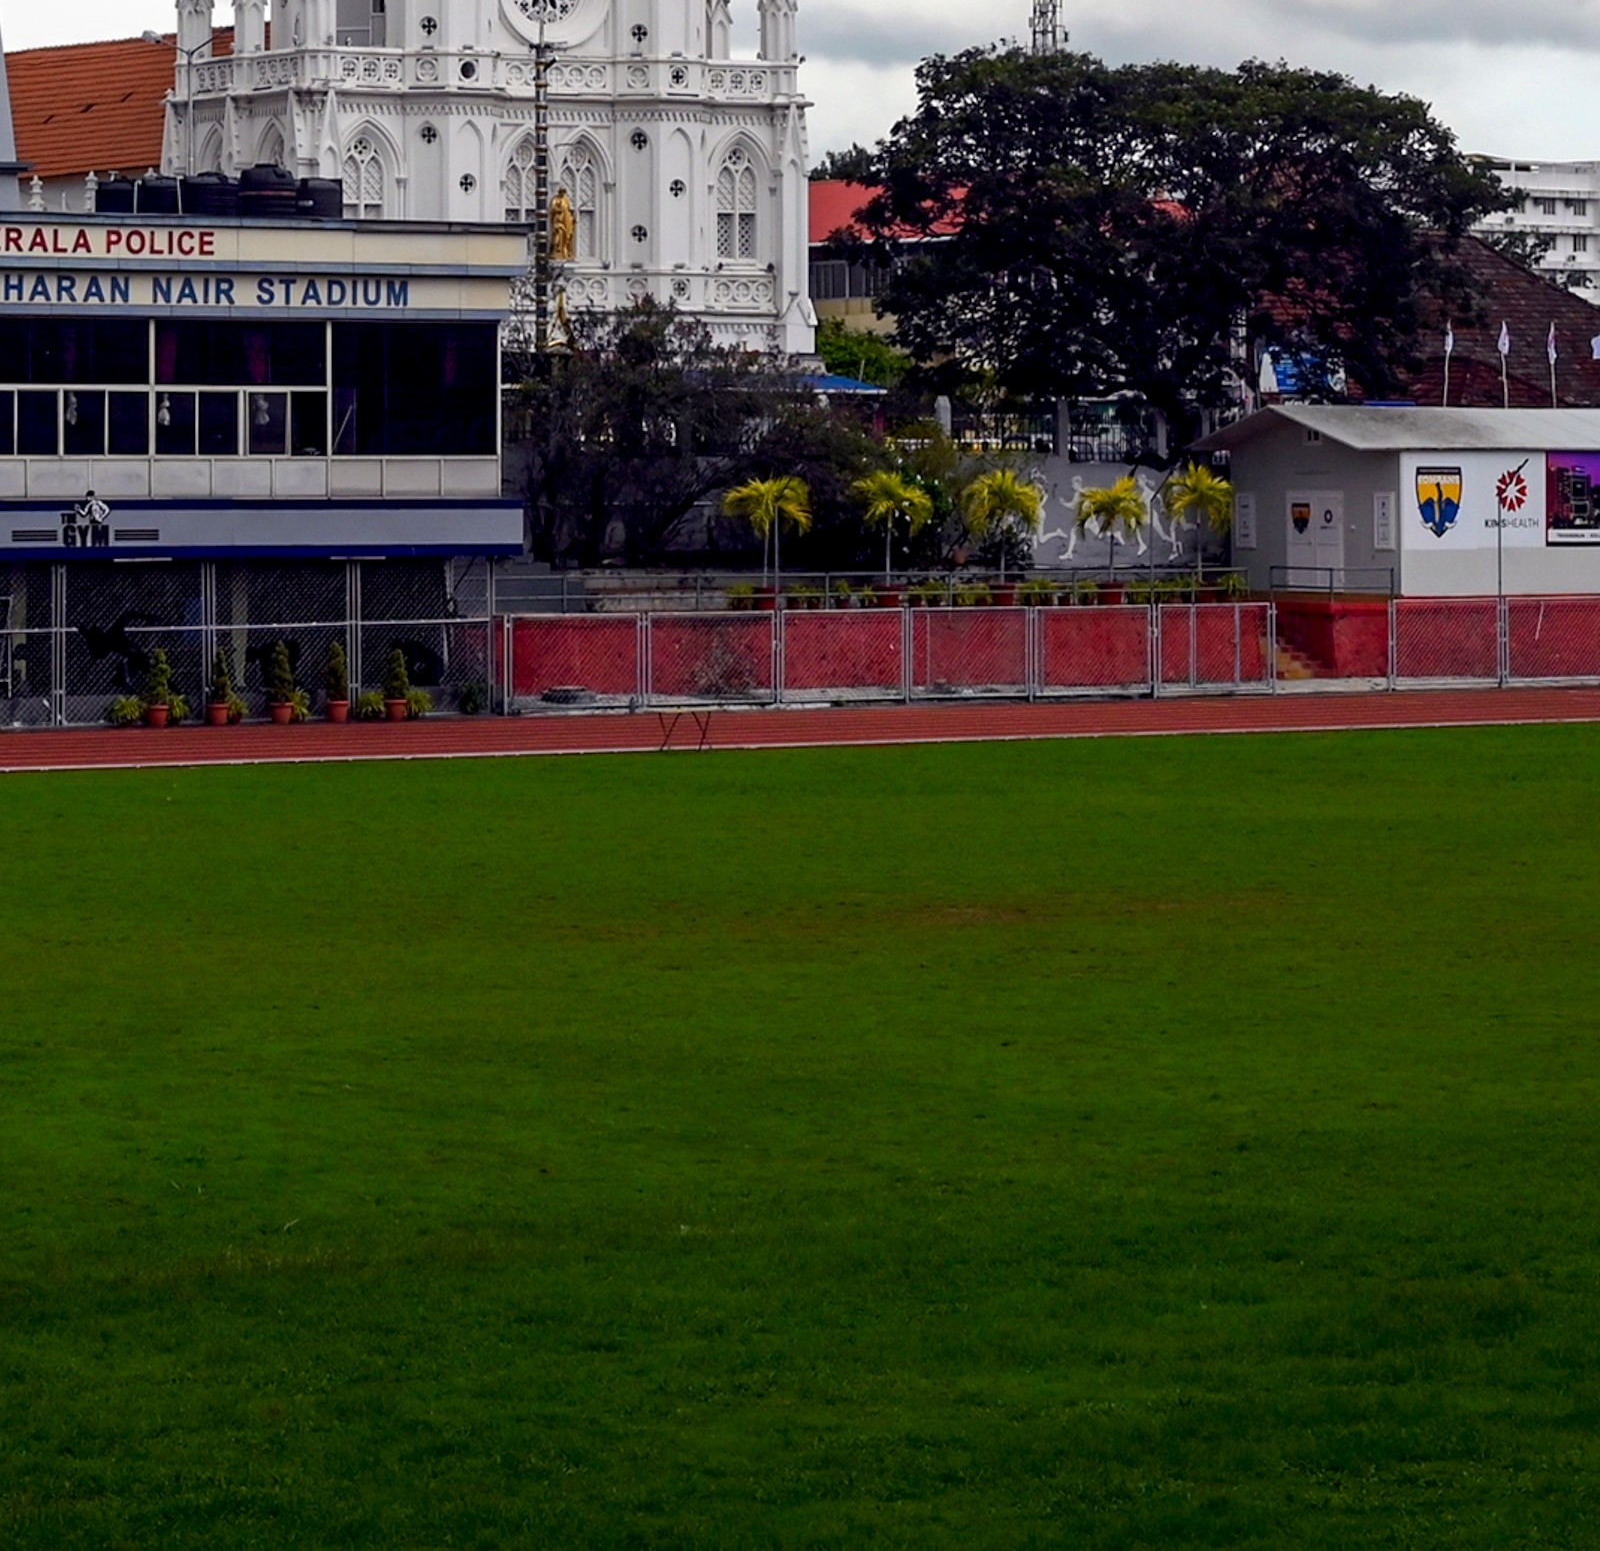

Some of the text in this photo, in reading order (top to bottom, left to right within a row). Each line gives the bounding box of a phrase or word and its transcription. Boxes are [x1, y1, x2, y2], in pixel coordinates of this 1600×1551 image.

[106, 229, 215, 256] POLICE
[152, 276, 236, 306] NAIR
[255, 277, 409, 308] STADIUM
[62, 524, 110, 548] GYM
